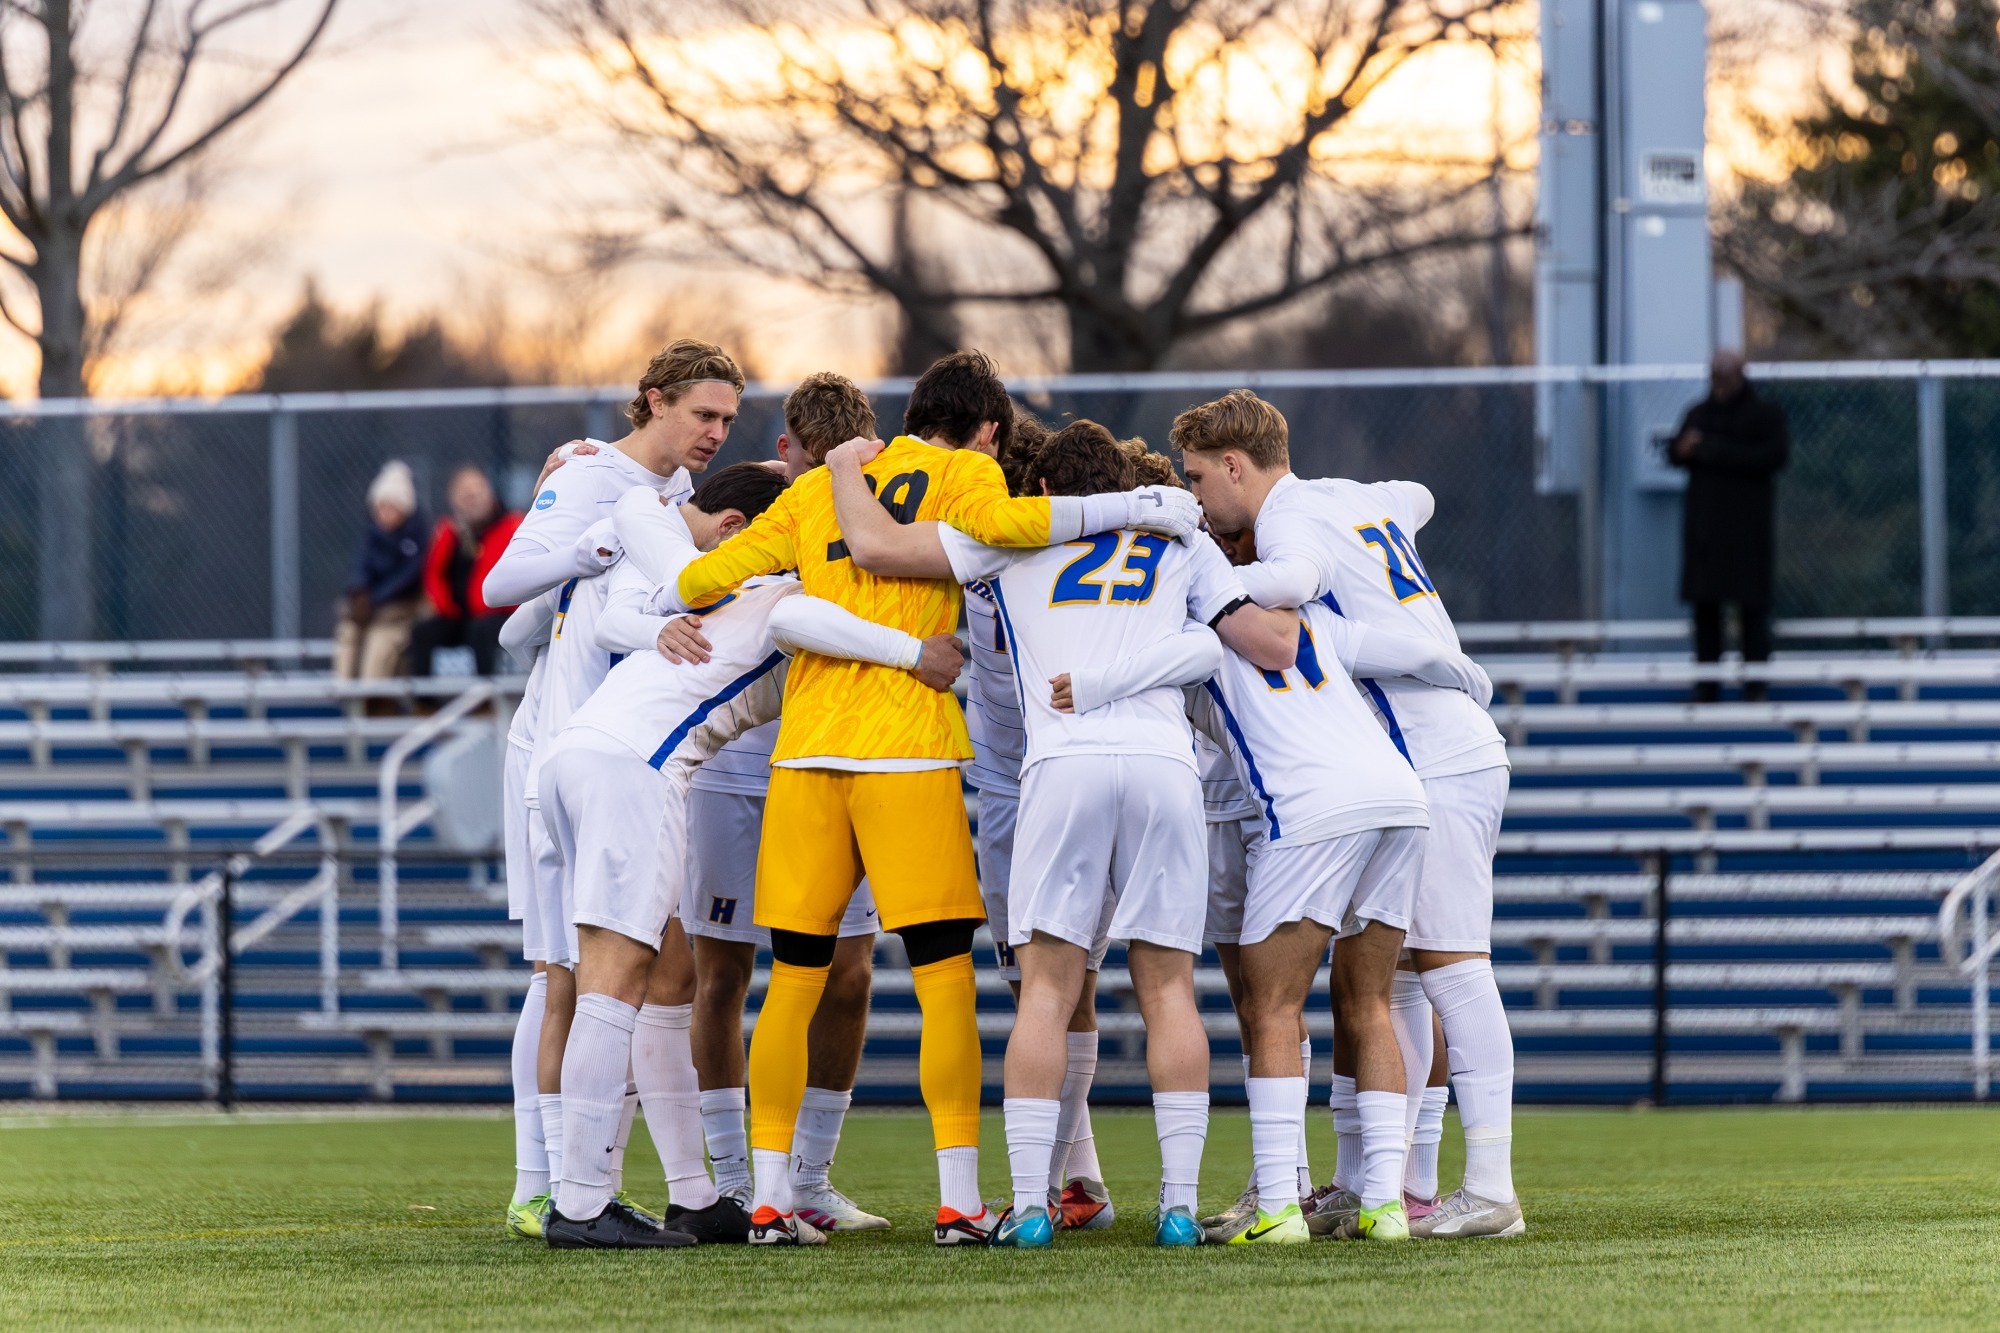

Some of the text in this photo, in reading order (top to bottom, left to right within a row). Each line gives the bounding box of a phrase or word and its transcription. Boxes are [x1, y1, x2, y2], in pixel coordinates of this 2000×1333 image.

[1048, 530, 1172, 609] 23
[1352, 517, 1437, 605] 20
[709, 895, 738, 925] H
